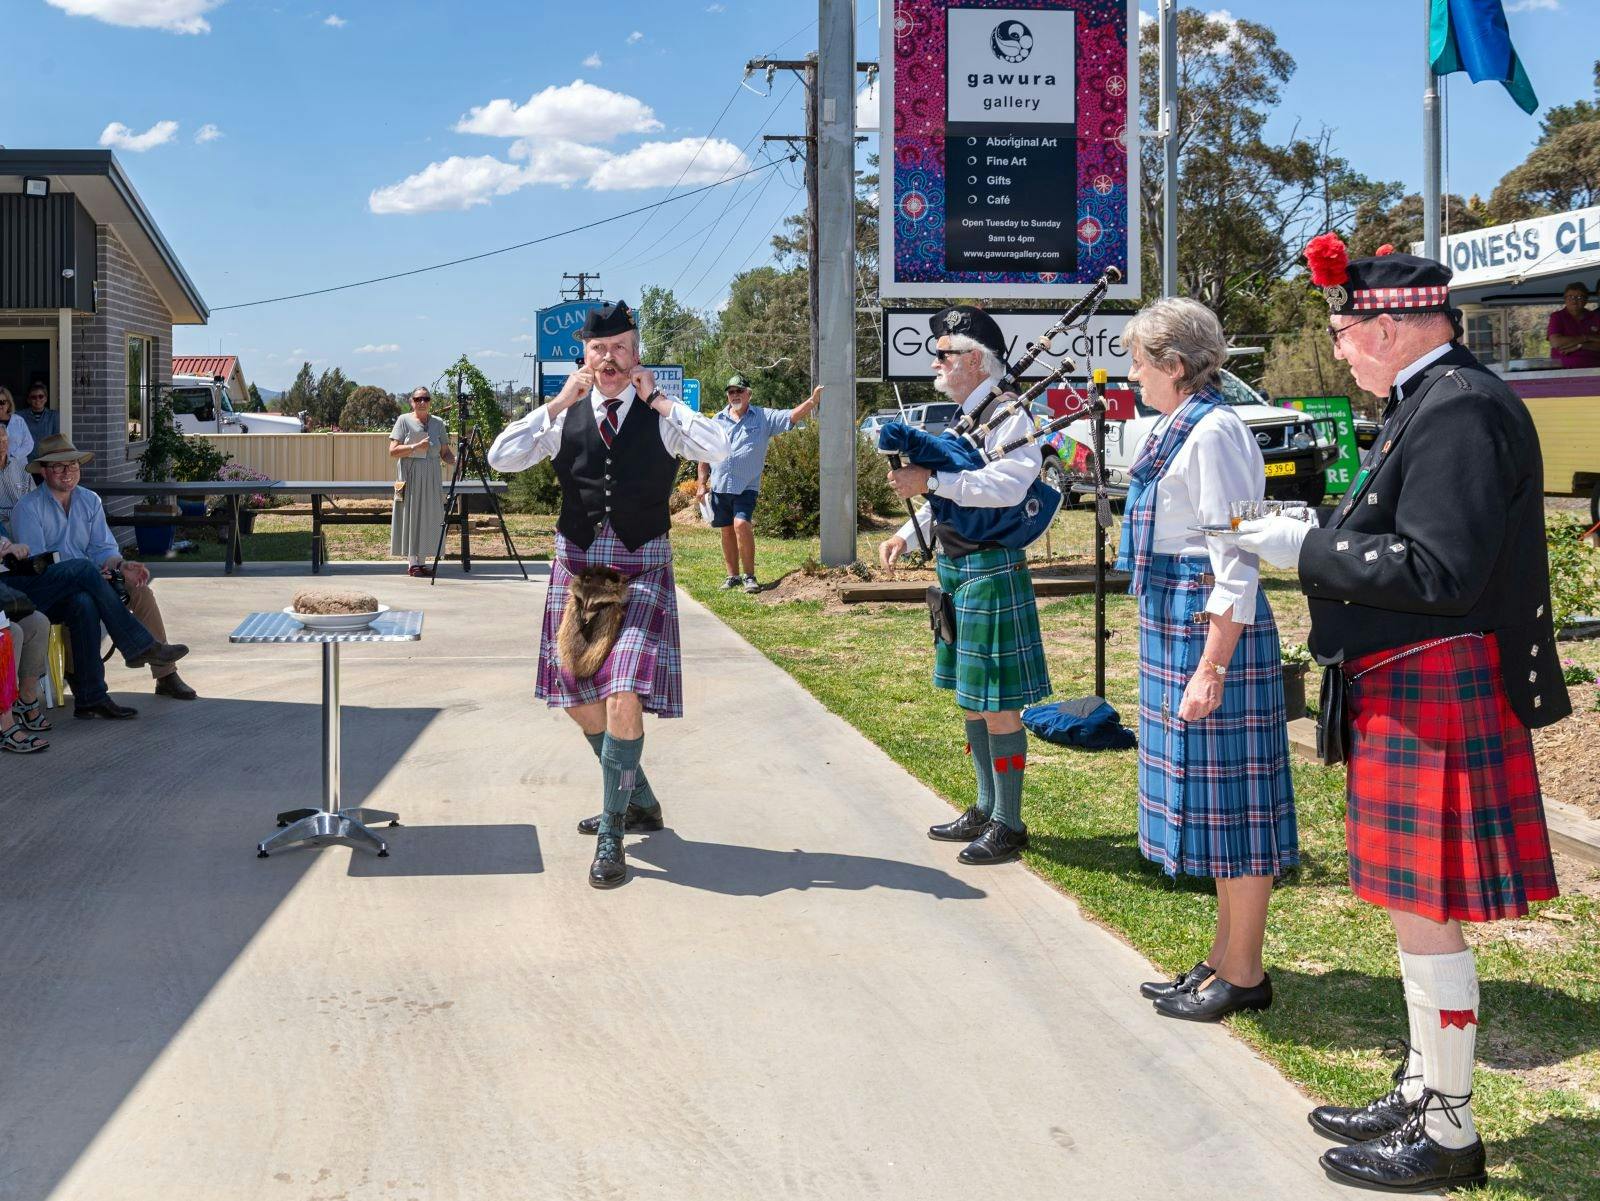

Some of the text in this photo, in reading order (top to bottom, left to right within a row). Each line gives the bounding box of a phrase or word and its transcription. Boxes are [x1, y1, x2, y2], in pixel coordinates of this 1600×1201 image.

[967, 72, 1056, 88] gawura
[983, 96, 1041, 110] gallery
[986, 137, 1057, 149] Aboriginal Art
[986, 156, 1027, 166] Fine Art
[986, 175, 1011, 185] Gifts
[987, 195, 1010, 205] Café
[962, 219, 1061, 229] Open Tuesday to Sunday
[988, 235, 1035, 244] 9am to 4pm
[1448, 217, 1600, 272] IONESS CL
[963, 250, 1060, 260] www.gawuragallery.com
[543, 309, 587, 335] CLAN
[653, 370, 680, 380] OTEL
[1065, 394, 1118, 411] On
